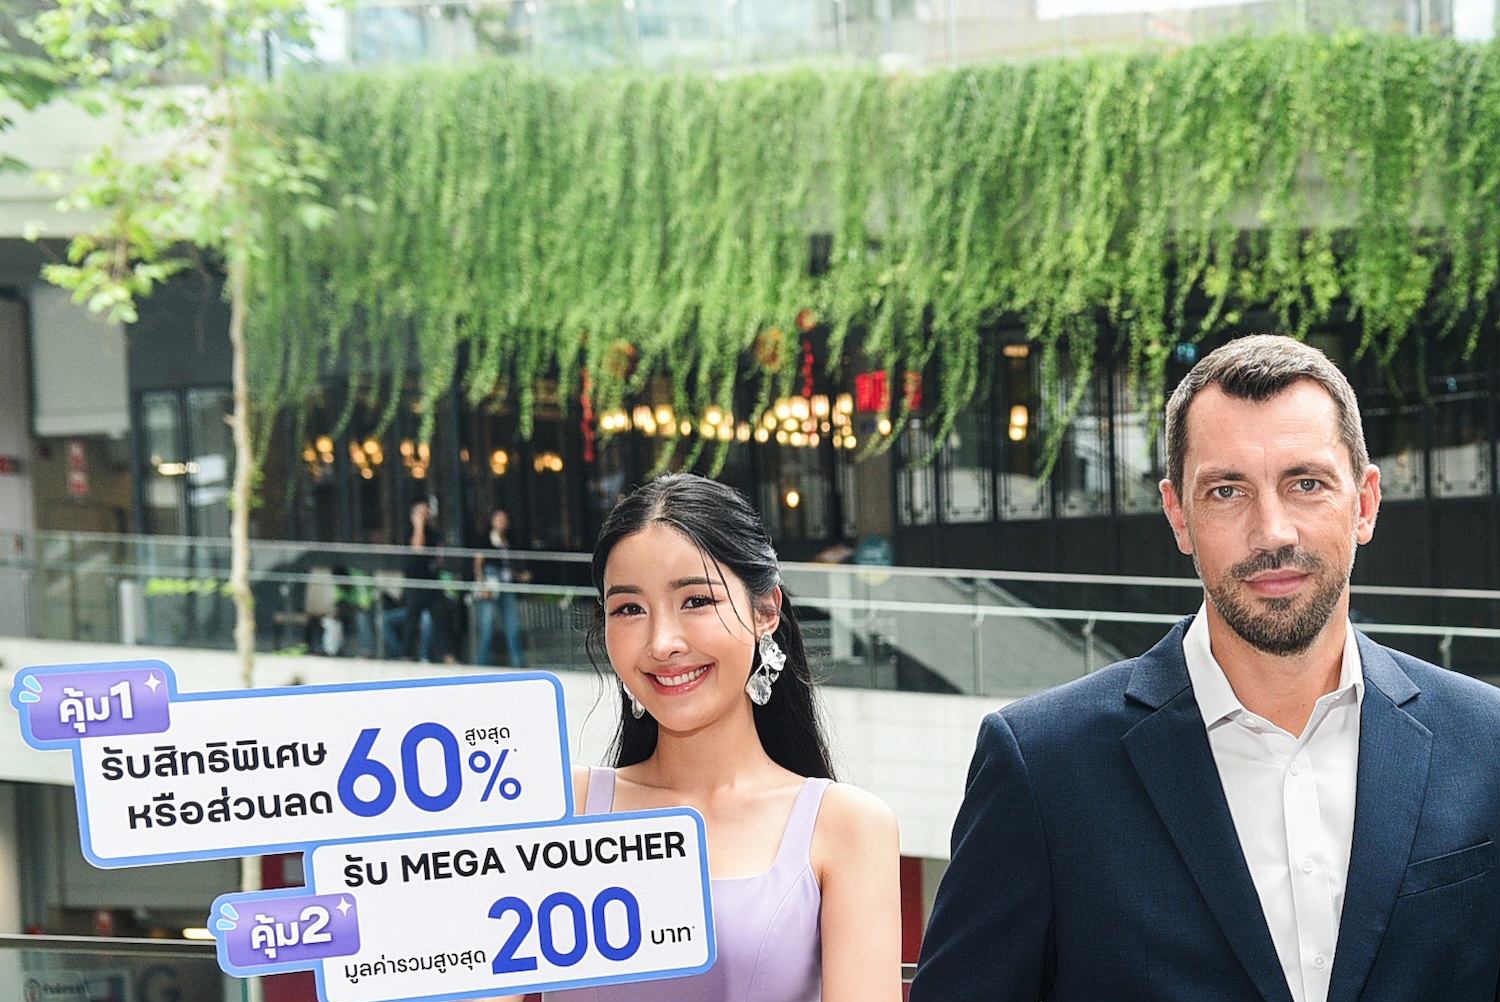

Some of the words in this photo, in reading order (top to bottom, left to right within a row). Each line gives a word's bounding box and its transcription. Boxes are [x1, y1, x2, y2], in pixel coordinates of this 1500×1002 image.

[60, 681, 133, 733] คุ้ม1
[101, 739, 327, 781] รับสิทธิพิเศษ
[465, 726, 511, 747] สูงสุด
[128, 786, 333, 830] หรือส่วนลด
[344, 854, 388, 888] รับ
[401, 846, 505, 883] MEGA
[520, 831, 687, 872] VOUCHER
[251, 905, 332, 959] คุ้ม2
[344, 950, 487, 984] มูลค่ารวมสูงสุด
[487, 886, 642, 975] 200
